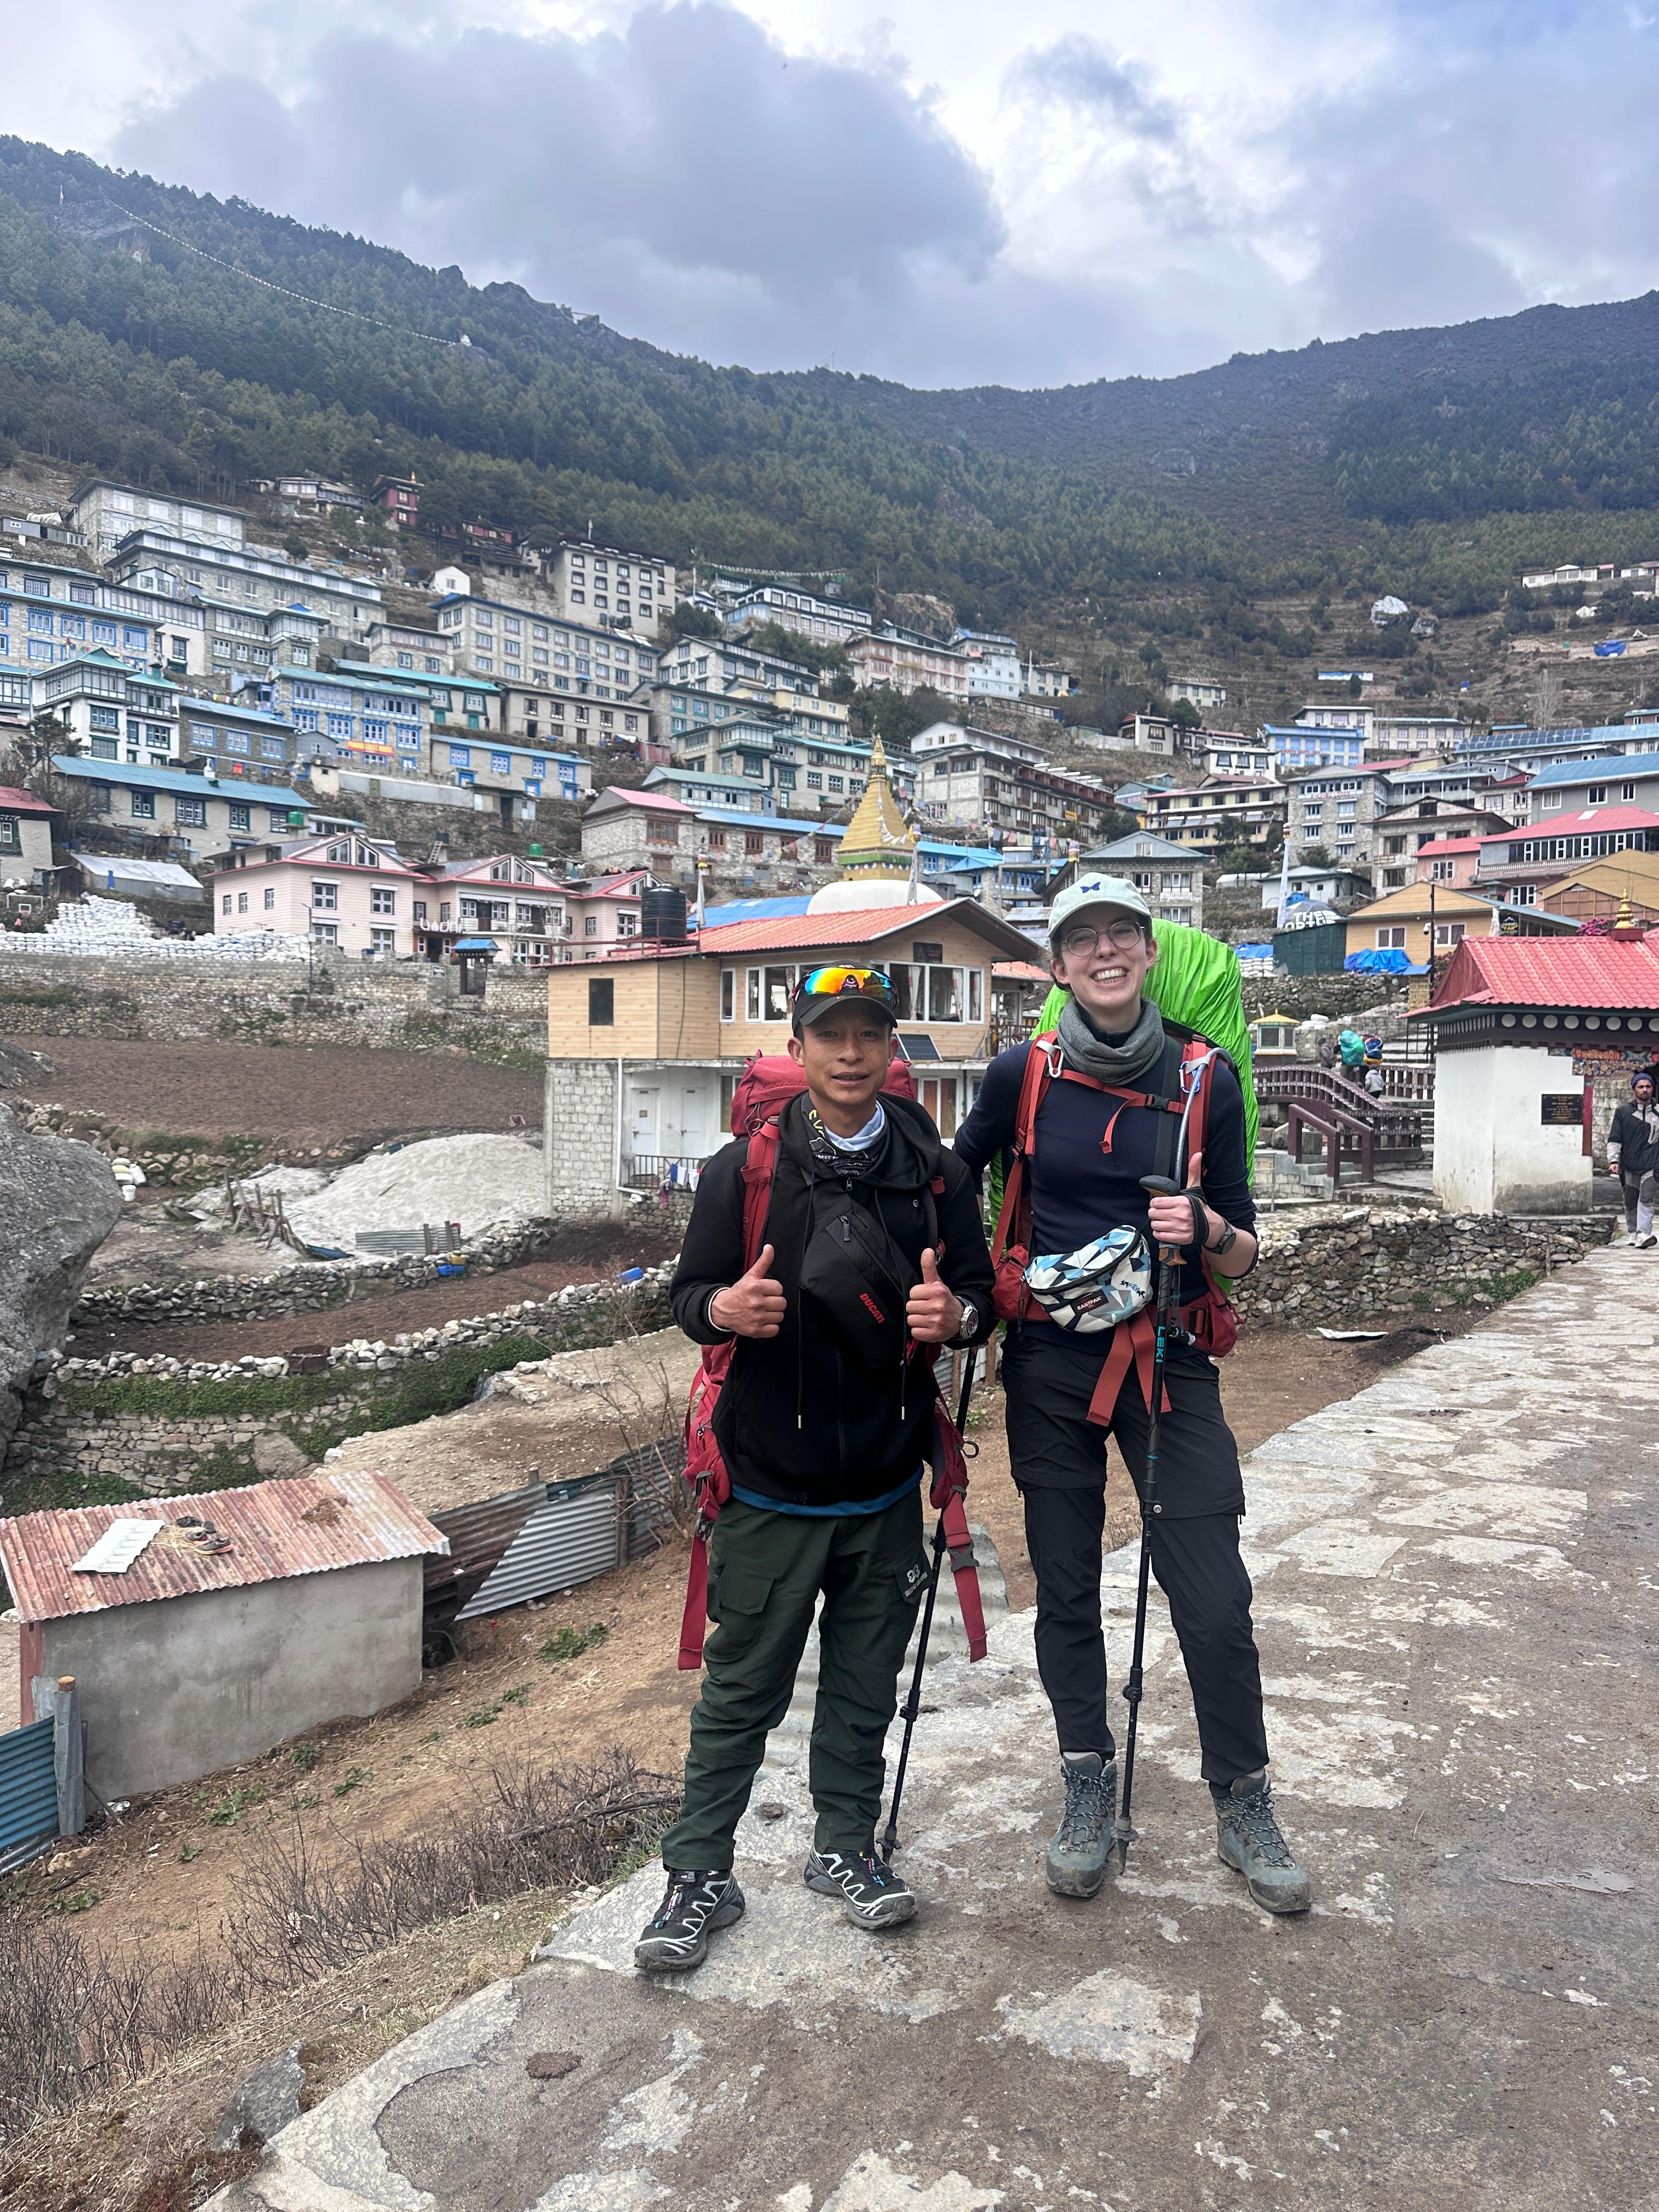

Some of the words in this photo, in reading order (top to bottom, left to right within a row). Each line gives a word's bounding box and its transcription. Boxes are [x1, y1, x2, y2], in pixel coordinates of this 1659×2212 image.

[1294, 911, 1324, 922] THE
[860, 1293, 885, 1323] DUCATI
[1076, 1295, 1102, 1310] EASTPAK
[1155, 1326, 1166, 1363] LEKI
